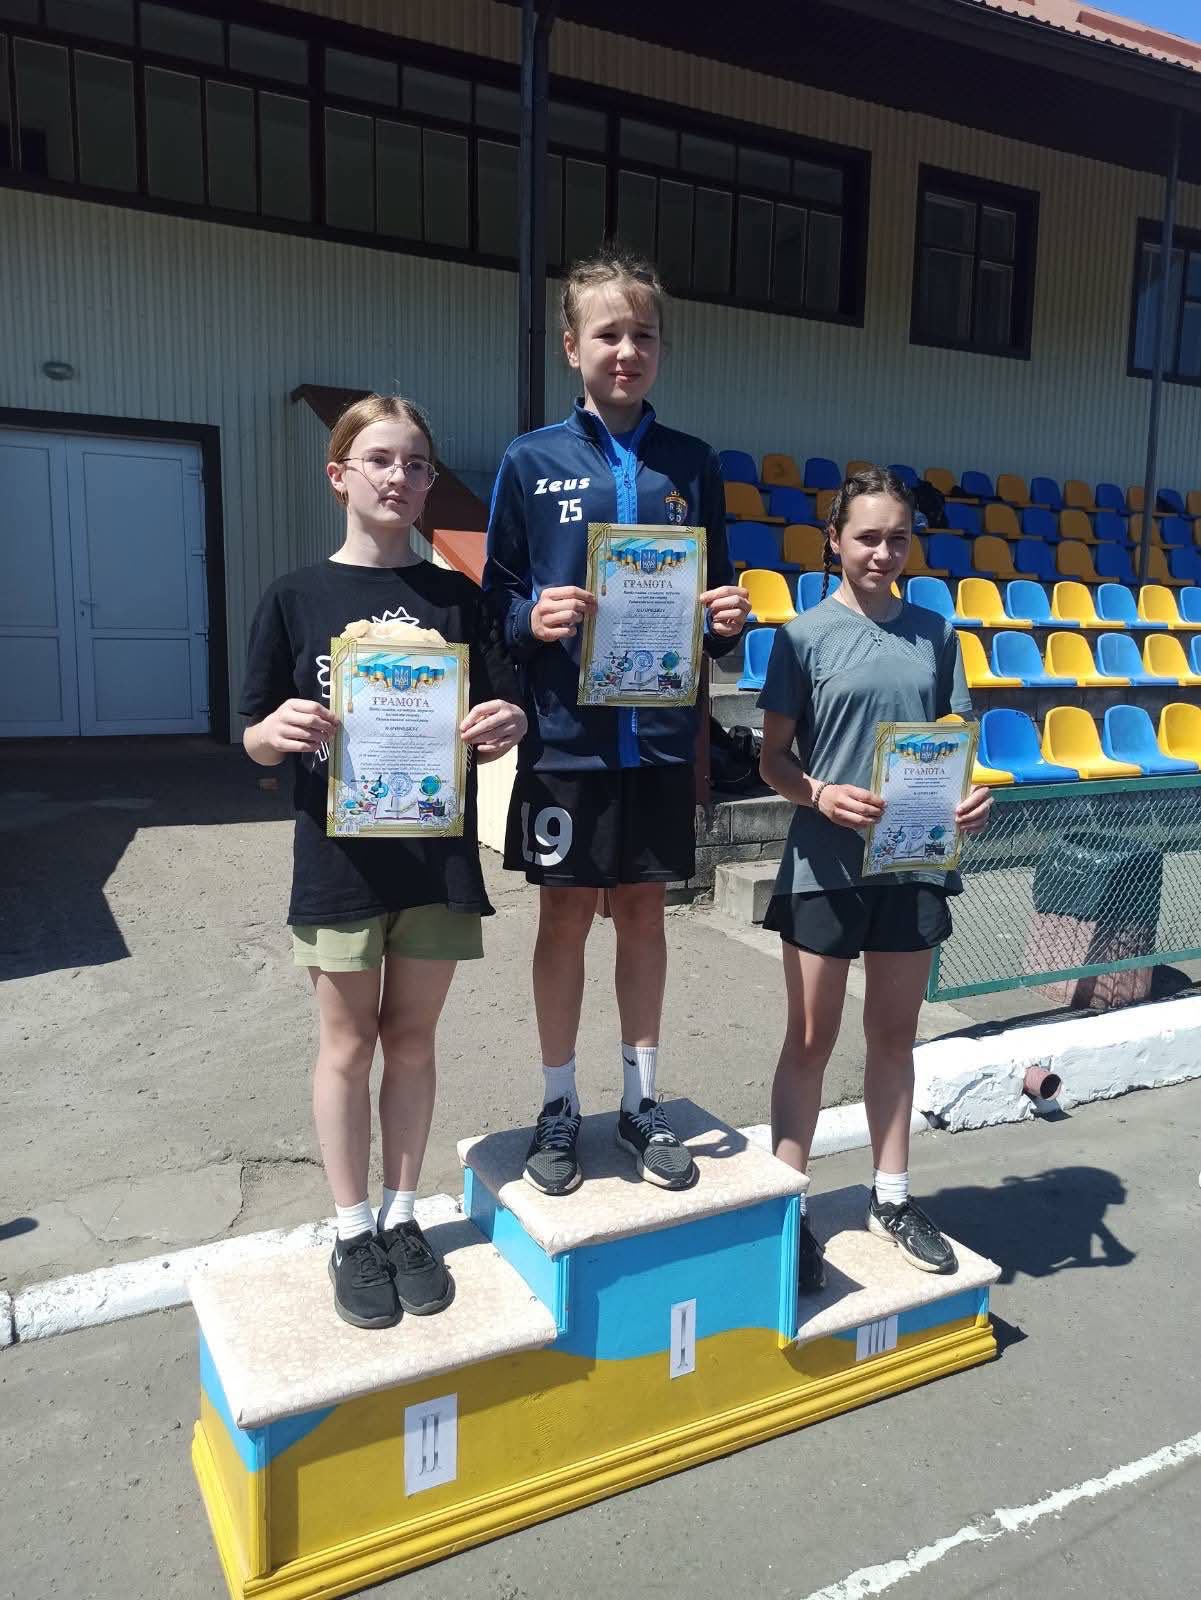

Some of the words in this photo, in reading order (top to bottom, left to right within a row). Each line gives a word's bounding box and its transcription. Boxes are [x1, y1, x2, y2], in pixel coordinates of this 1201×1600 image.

[533, 477, 591, 495] Zeus
[623, 579, 673, 589] ГРАМОТА
[372, 696, 431, 707] ГРАМОТА
[903, 767, 945, 775] ГРАМОТА
